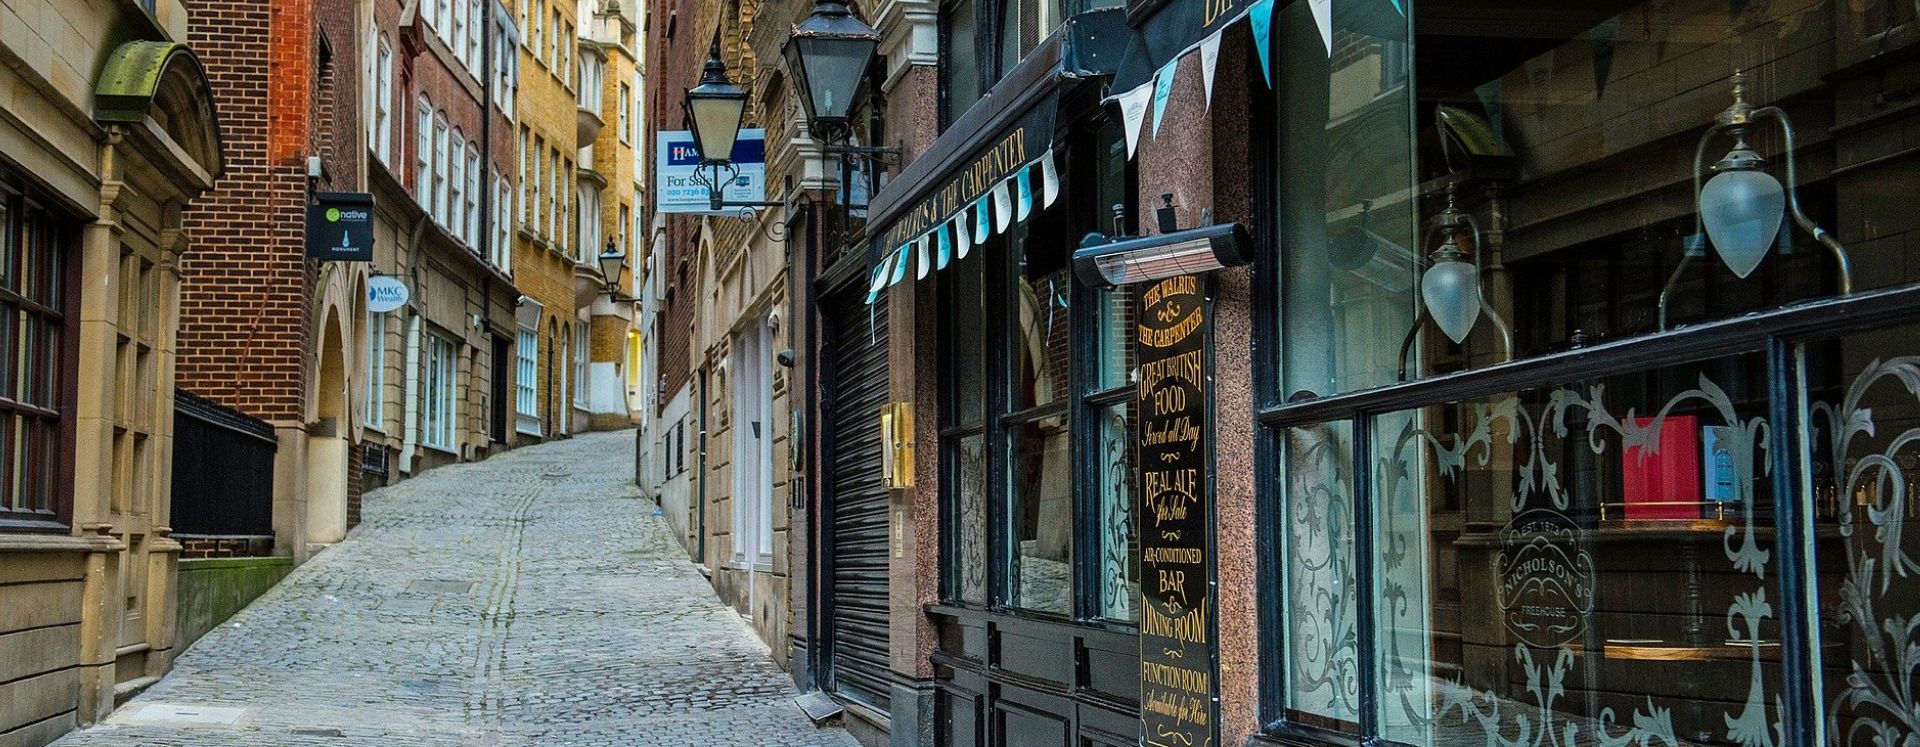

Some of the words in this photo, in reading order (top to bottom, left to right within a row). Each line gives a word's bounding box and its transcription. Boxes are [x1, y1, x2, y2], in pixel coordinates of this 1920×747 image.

[667, 175, 686, 187] For
[930, 193, 938, 224] &
[941, 178, 959, 220] THE
[961, 127, 1026, 203] CARPENTER
[340, 210, 368, 219] native
[377, 286, 401, 295] MKC
[1143, 283, 1161, 311] THE
[1161, 275, 1197, 299] WALRUS
[1139, 324, 1154, 347] THE
[1154, 306, 1203, 348] CARPENTER
[1157, 300, 1181, 323] &
[1140, 358, 1166, 400] GREAT
[1166, 349, 1202, 393] BRITISH
[1155, 385, 1186, 416] FOOD
[1142, 419, 1169, 447] Served
[1179, 416, 1200, 452] Day
[1145, 471, 1173, 514] REAL
[1174, 468, 1197, 503] ALE
[1156, 496, 1169, 528] for
[1168, 495, 1188, 520] Sale
[1143, 547, 1202, 568] AIR-CONDITIONED
[1159, 570, 1187, 606] BAR
[1504, 557, 1582, 598] NICHOLSON'S
[1142, 591, 1174, 639] DINING
[1174, 596, 1206, 650] ROOM
[1161, 595, 1183, 614] &
[1521, 605, 1566, 618] FREEHOUSE
[1142, 661, 1181, 689] FUNCTION
[1181, 669, 1207, 696] ROOM
[1143, 688, 1177, 718] Available
[1177, 695, 1189, 727] for
[1189, 697, 1208, 726] Hire
